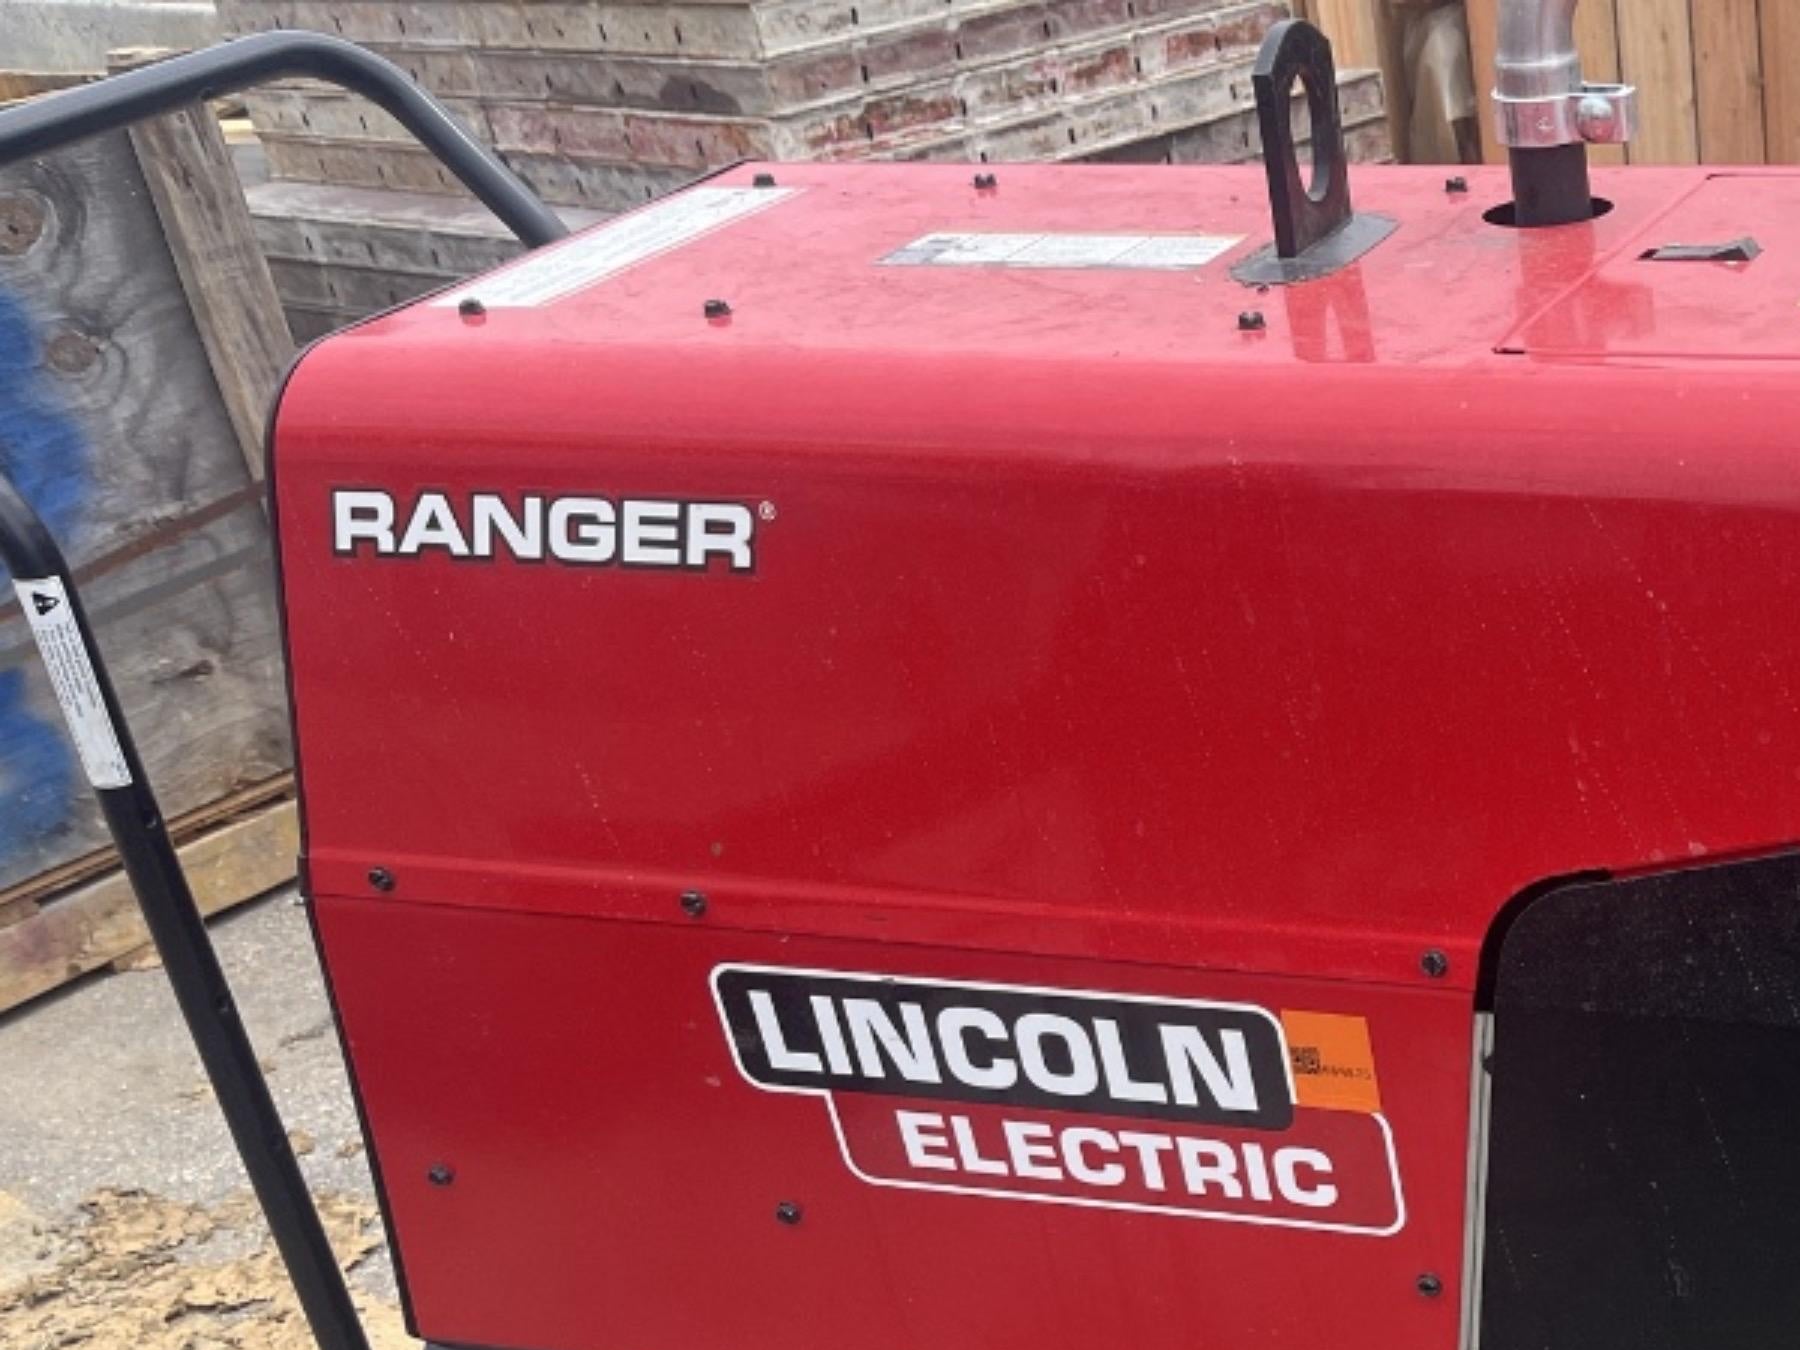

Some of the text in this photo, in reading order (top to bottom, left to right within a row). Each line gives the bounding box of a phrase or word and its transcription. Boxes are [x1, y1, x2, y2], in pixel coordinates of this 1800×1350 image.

[334, 489, 754, 569] RANGER
[748, 989, 1259, 1112] LINCOLN
[895, 1109, 1339, 1208] ELECTRIC
